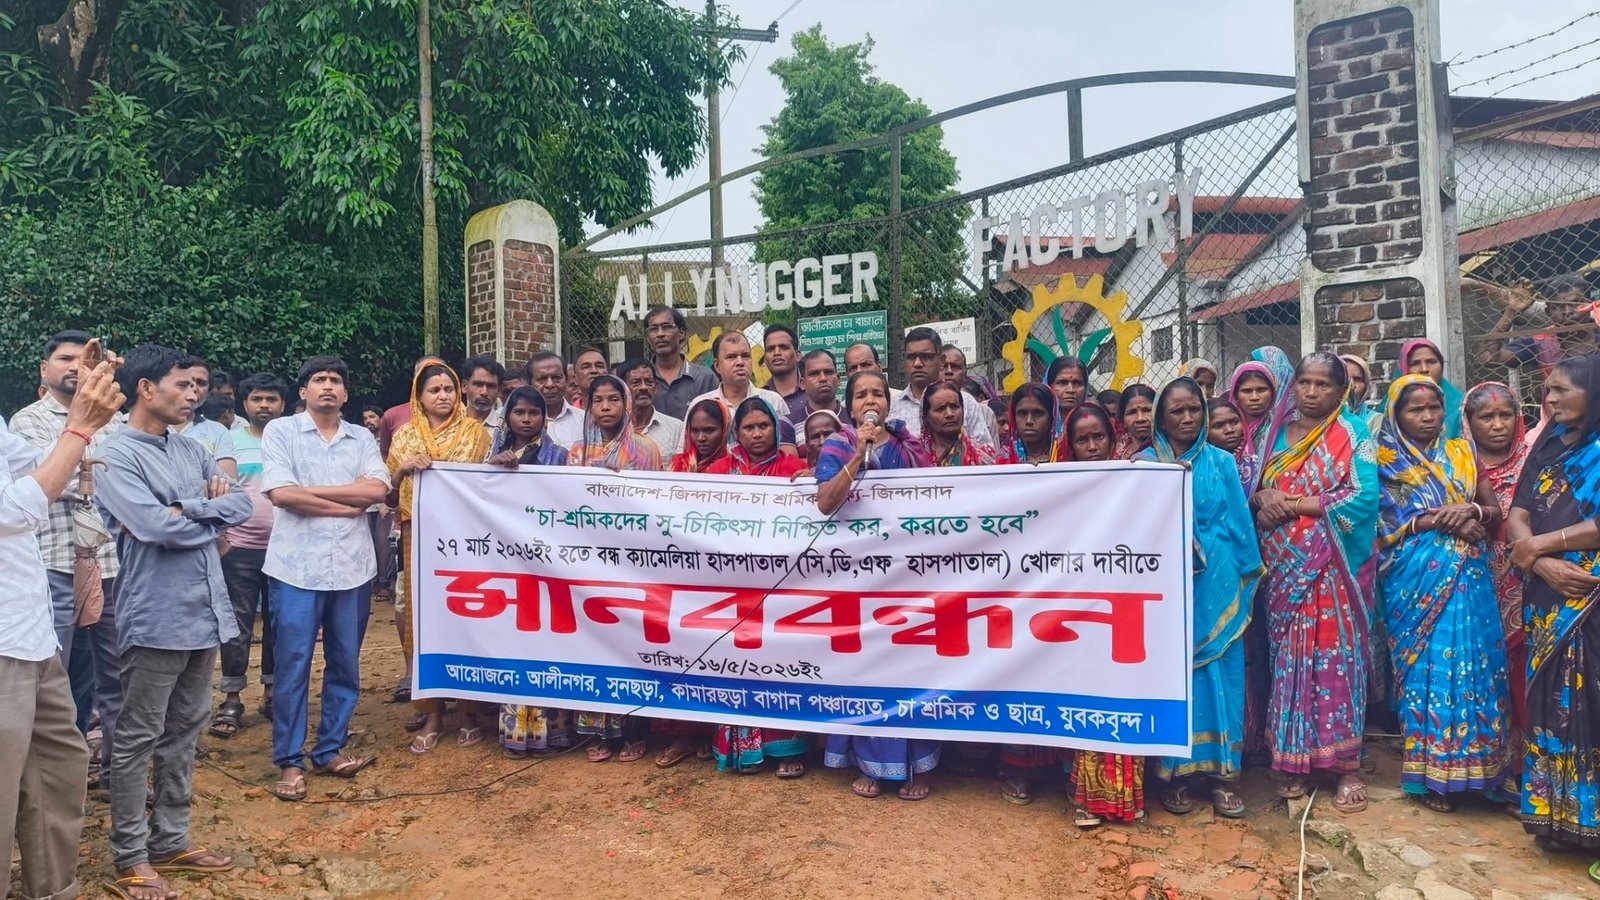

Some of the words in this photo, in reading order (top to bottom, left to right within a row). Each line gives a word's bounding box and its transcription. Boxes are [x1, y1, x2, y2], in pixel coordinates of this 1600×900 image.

[609, 251, 880, 321] ALLYNUGGER
[973, 168, 1202, 275] FACTORY
[800, 318, 841, 332] আলীনগর
[843, 318, 853, 328] চা
[854, 315, 884, 327] বাগান
[585, 483, 766, 506] বাংলাদেশ-জিন্দাবাদ-চা
[773, 491, 817, 507] শ্রমিক
[655, 511, 766, 539] সু-চিকিৎসা
[772, 514, 841, 539] নিশ্চিত
[845, 517, 889, 541] কর,
[898, 516, 970, 536] করতে
[979, 509, 1040, 536] হবে”
[436, 538, 459, 557] ২৭
[466, 532, 491, 557] মার্চ
[497, 537, 552, 564] ২০২৬ইং
[558, 544, 591, 562] হতে
[597, 545, 621, 566] বন্ধ
[626, 544, 701, 573] ক্যামেলিয়া
[706, 551, 790, 575] হাসপাতাল
[797, 547, 892, 579] (সি,ডি,এফ
[906, 548, 1012, 580] হাসপাতাল)
[1020, 552, 1083, 574] খোলার
[1093, 543, 1162, 576] দাবীতে
[434, 569, 1164, 664] মানববন্ধন
[637, 650, 690, 670] তারিখ:
[697, 657, 823, 680] ১৬/৫/২০২৬ইং
[444, 662, 520, 688] আয়োজনে:
[526, 665, 600, 697] আলীনগর,
[606, 678, 664, 703] সুনছড়া,
[671, 682, 748, 709] কামারছড়া
[753, 688, 802, 713] বাগান
[807, 693, 889, 722] পঞ্চায়েত,
[896, 699, 916, 720] চা
[920, 694, 977, 722] শ্রমিক
[983, 704, 999, 720] ও
[1008, 701, 1051, 729] ছাত্র,
